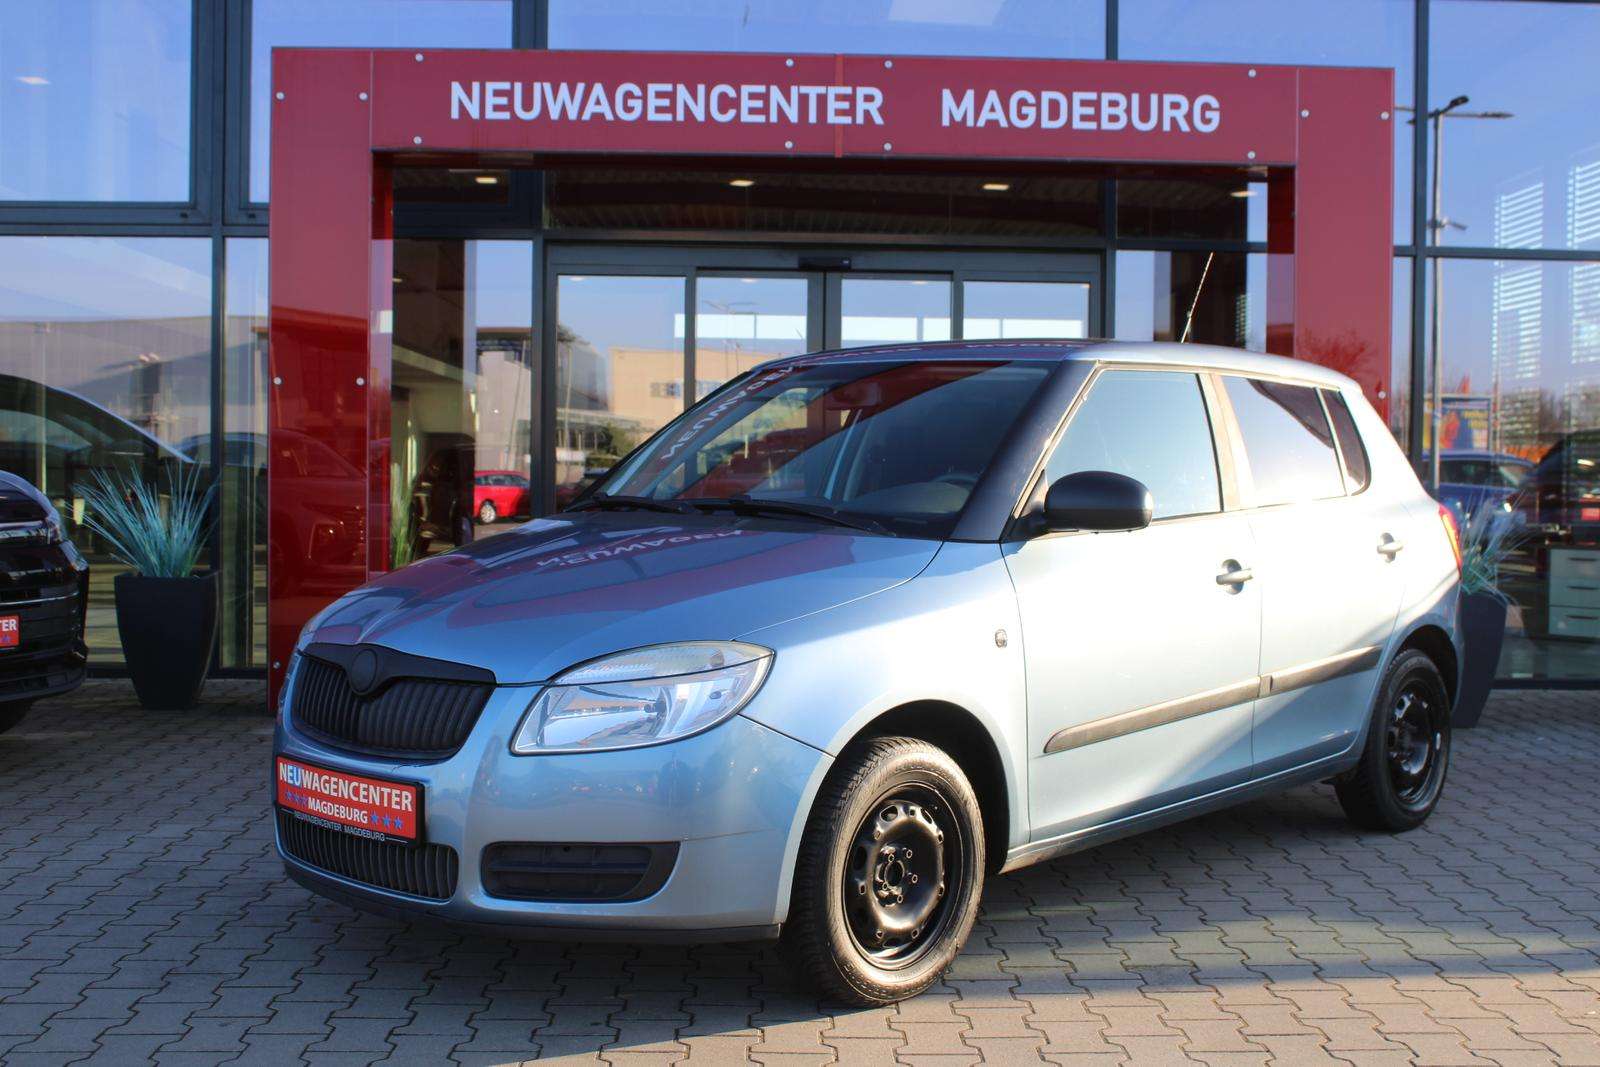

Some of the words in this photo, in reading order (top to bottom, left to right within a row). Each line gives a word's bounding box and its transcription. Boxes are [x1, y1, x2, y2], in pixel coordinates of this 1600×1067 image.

[450, 81, 885, 126] NEUWAGENCENTER
[941, 88, 1221, 133] MAGDEBURG
[0, 619, 17, 632] ER
[279, 762, 413, 812] NEUWAGENCENTER
[307, 796, 369, 824] MAGDEBURG
[343, 826, 386, 842] MAGDEBURG
